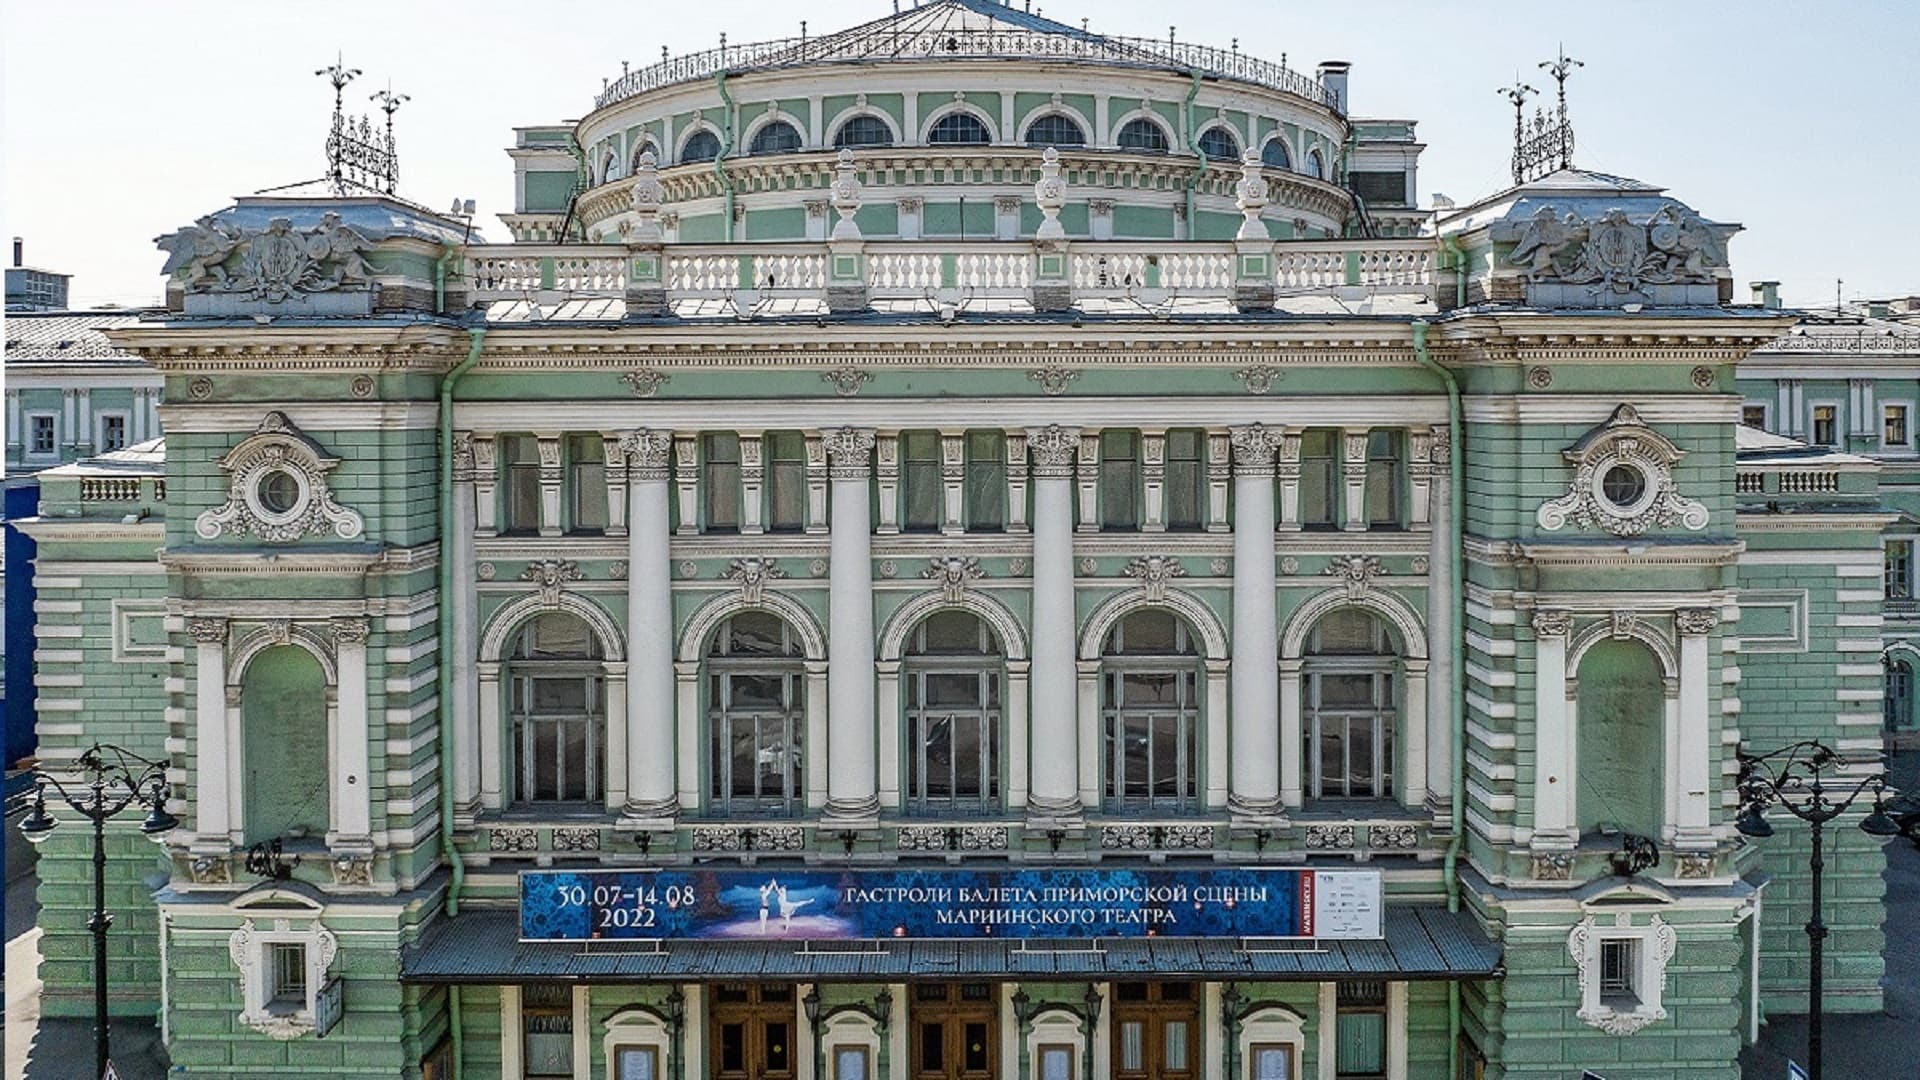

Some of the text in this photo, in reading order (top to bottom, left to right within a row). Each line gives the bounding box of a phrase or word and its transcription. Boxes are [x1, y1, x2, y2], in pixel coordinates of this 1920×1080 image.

[557, 885, 696, 908] 30.07-14.08
[843, 884, 1268, 904] ГАСТРОЛИ БАЛЕТА ПРИМОРСКОЙ СЦЕНЫ
[599, 908, 656, 928] 2022
[935, 908, 1177, 925] МАРИИНСКОГО ТЕАТРА
